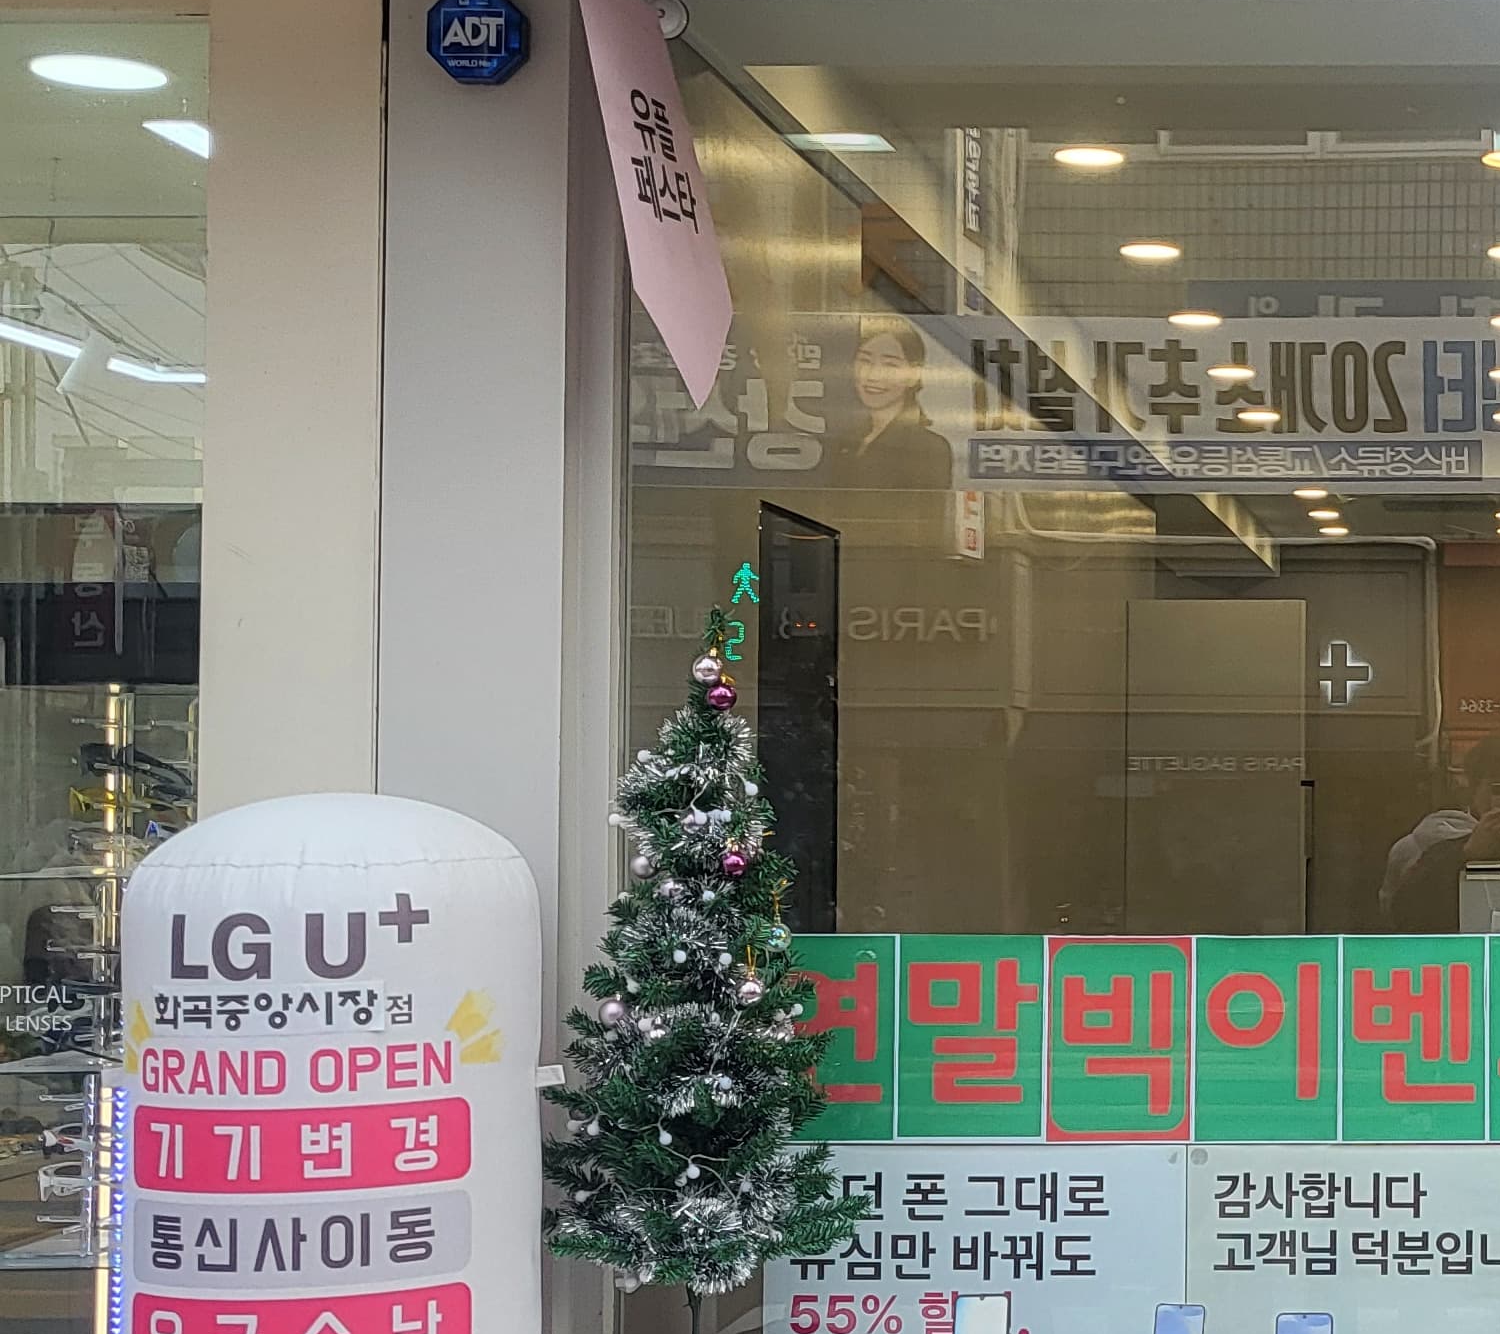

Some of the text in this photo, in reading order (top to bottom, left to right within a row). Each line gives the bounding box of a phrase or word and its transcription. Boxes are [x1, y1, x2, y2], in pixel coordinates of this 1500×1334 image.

[443, 16, 504, 48] ADT
[631, 155, 700, 235] 페스타
[170, 892, 430, 981] LG U+
[6, 1014, 73, 1033] LENSES
[153, 990, 414, 1031] 화곡중앙시장점
[142, 1039, 454, 1096] GRAND OPEN
[902, 1172, 949, 1222] 폰
[964, 1171, 1111, 1223] 그대로
[1213, 1172, 1428, 1222] 감사합니다
[150, 1205, 437, 1274] 통신사이동
[951, 1230, 1098, 1281] 바꿔도
[1212, 1228, 1338, 1279] 고객님
